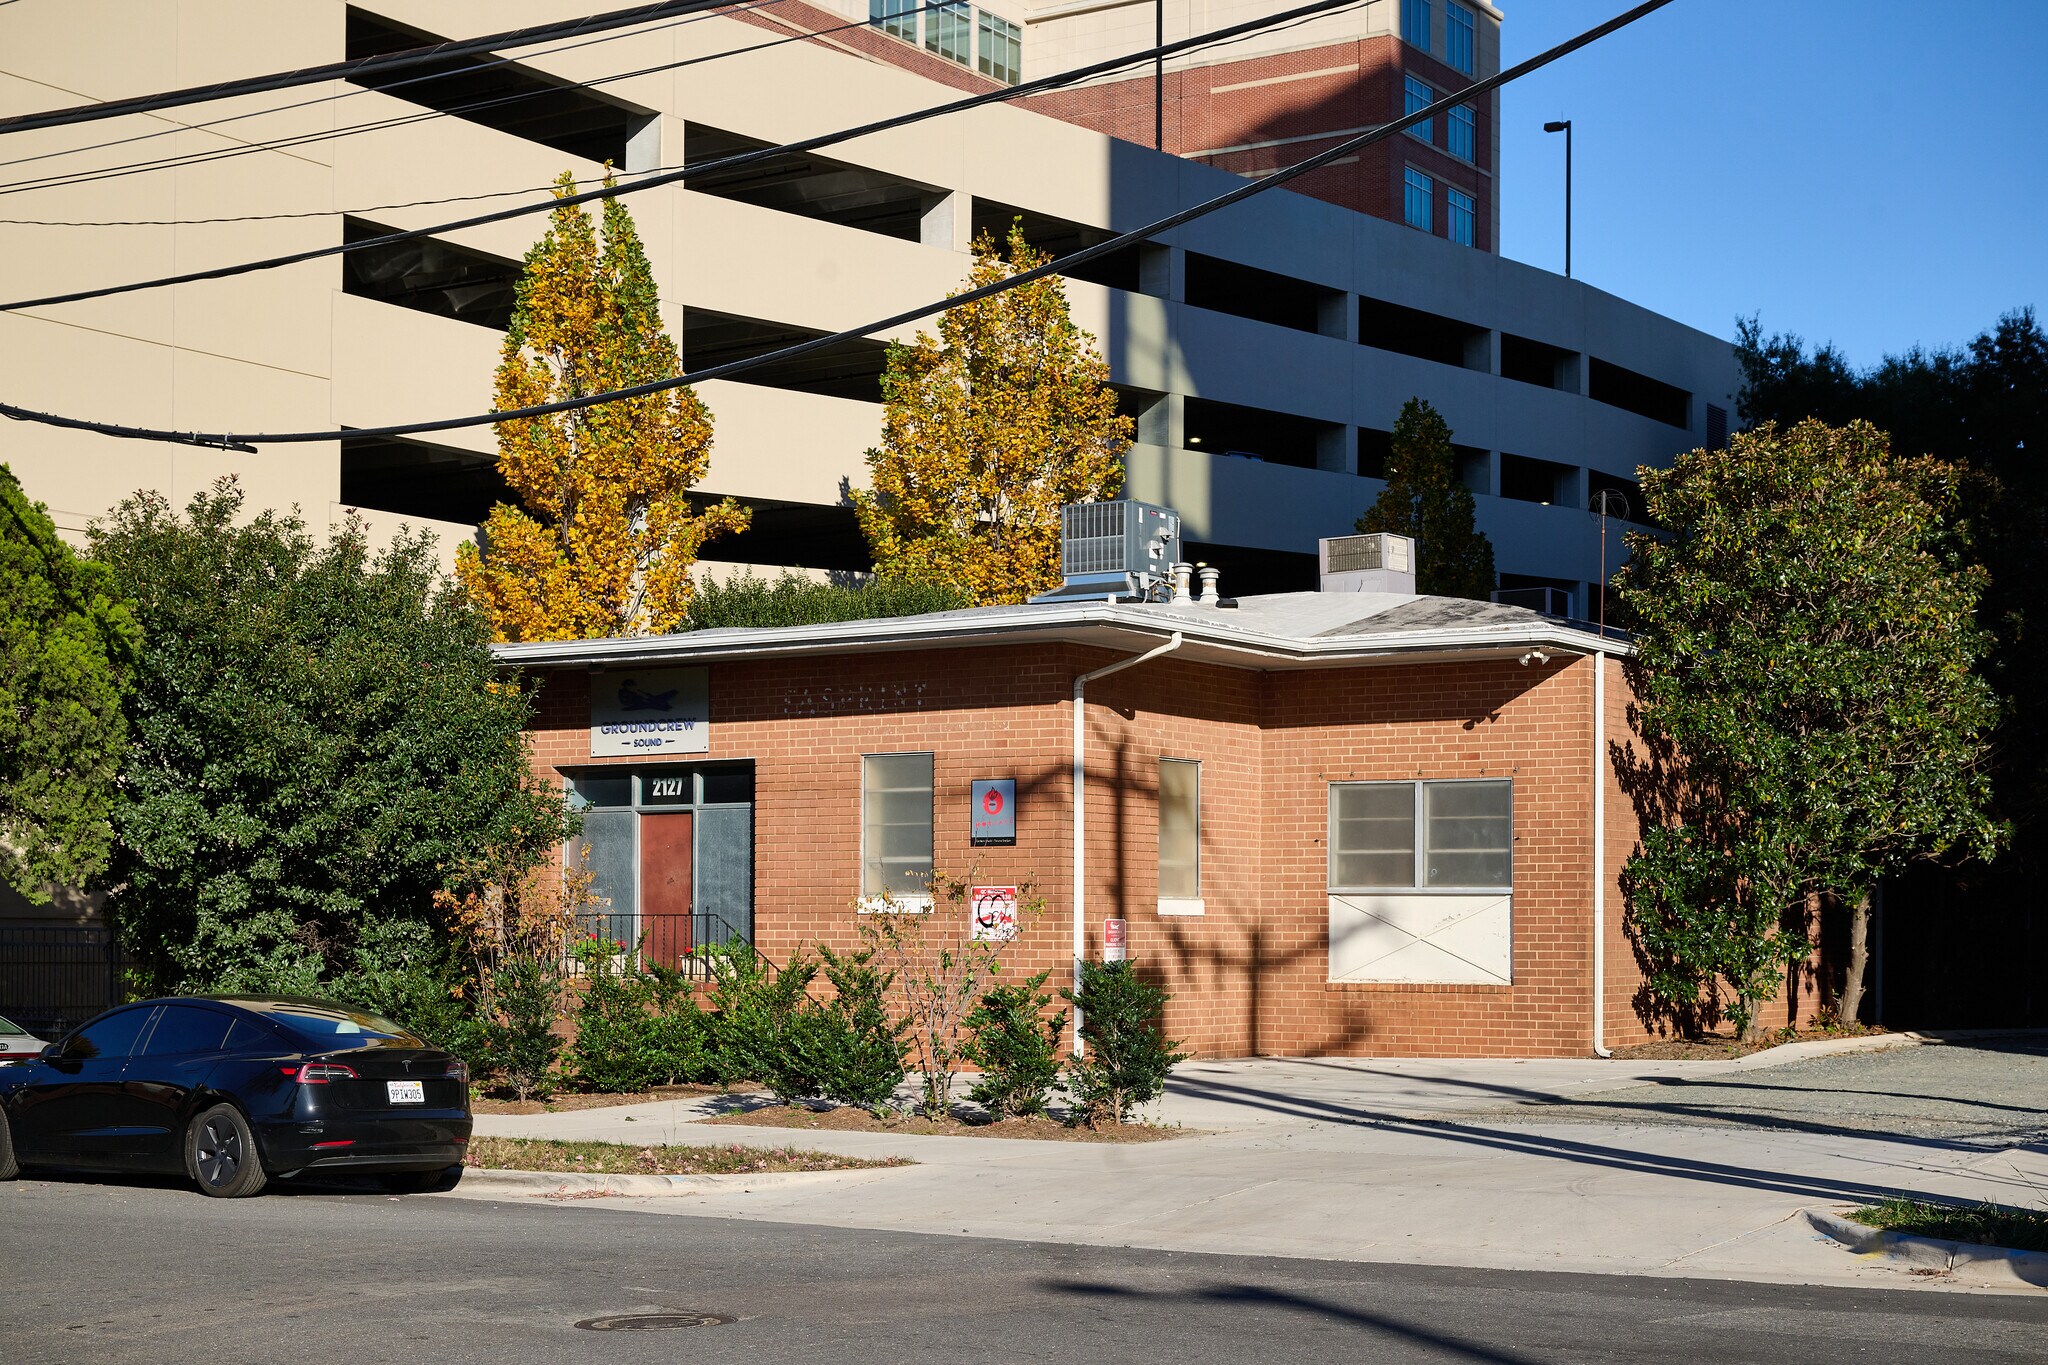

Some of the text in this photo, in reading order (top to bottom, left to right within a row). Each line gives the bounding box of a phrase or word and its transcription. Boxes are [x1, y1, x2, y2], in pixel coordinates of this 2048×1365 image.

[601, 717, 697, 735] GROUNDCREW
[633, 737, 662, 748] SOUND
[652, 777, 683, 797] 2127
[391, 1089, 422, 1100] 9PIW305
